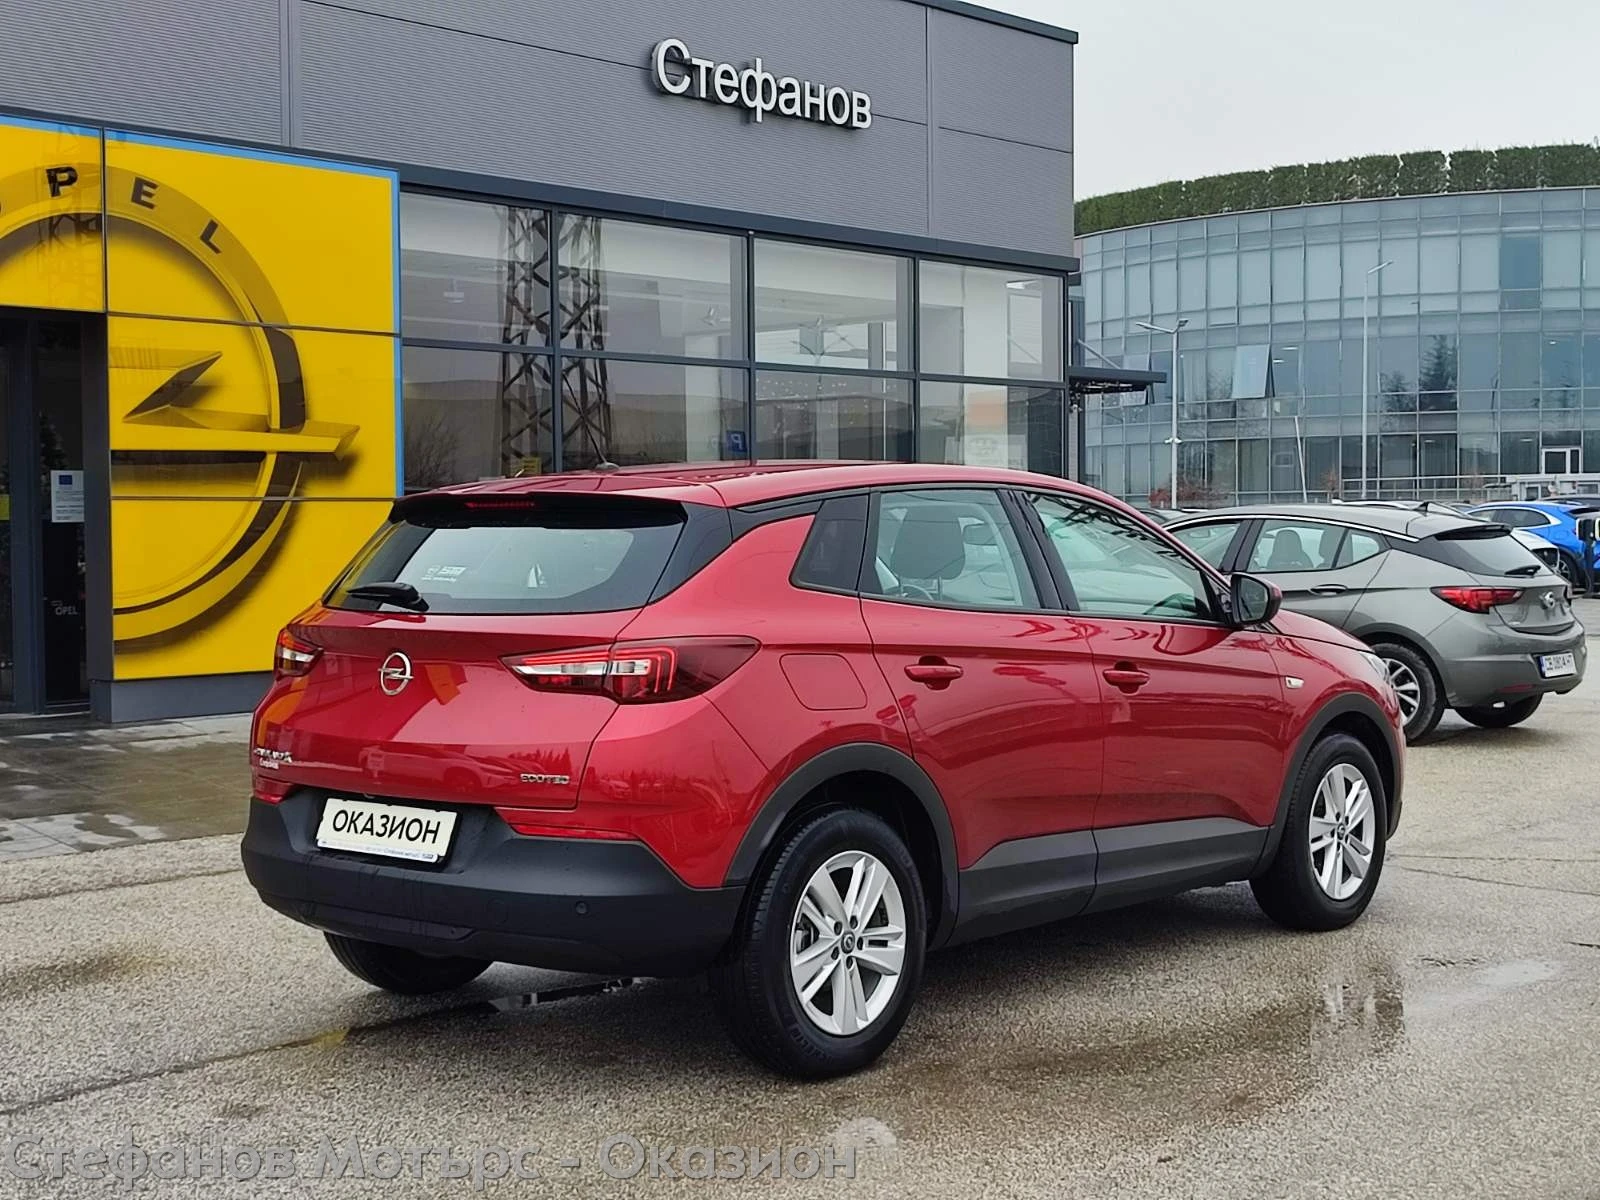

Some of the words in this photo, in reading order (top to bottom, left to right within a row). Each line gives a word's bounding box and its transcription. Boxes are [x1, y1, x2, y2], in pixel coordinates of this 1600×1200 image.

[653, 38, 872, 128] Стефанов
[0, 166, 221, 255] PEL
[332, 809, 441, 844] ОКАЗИОН
